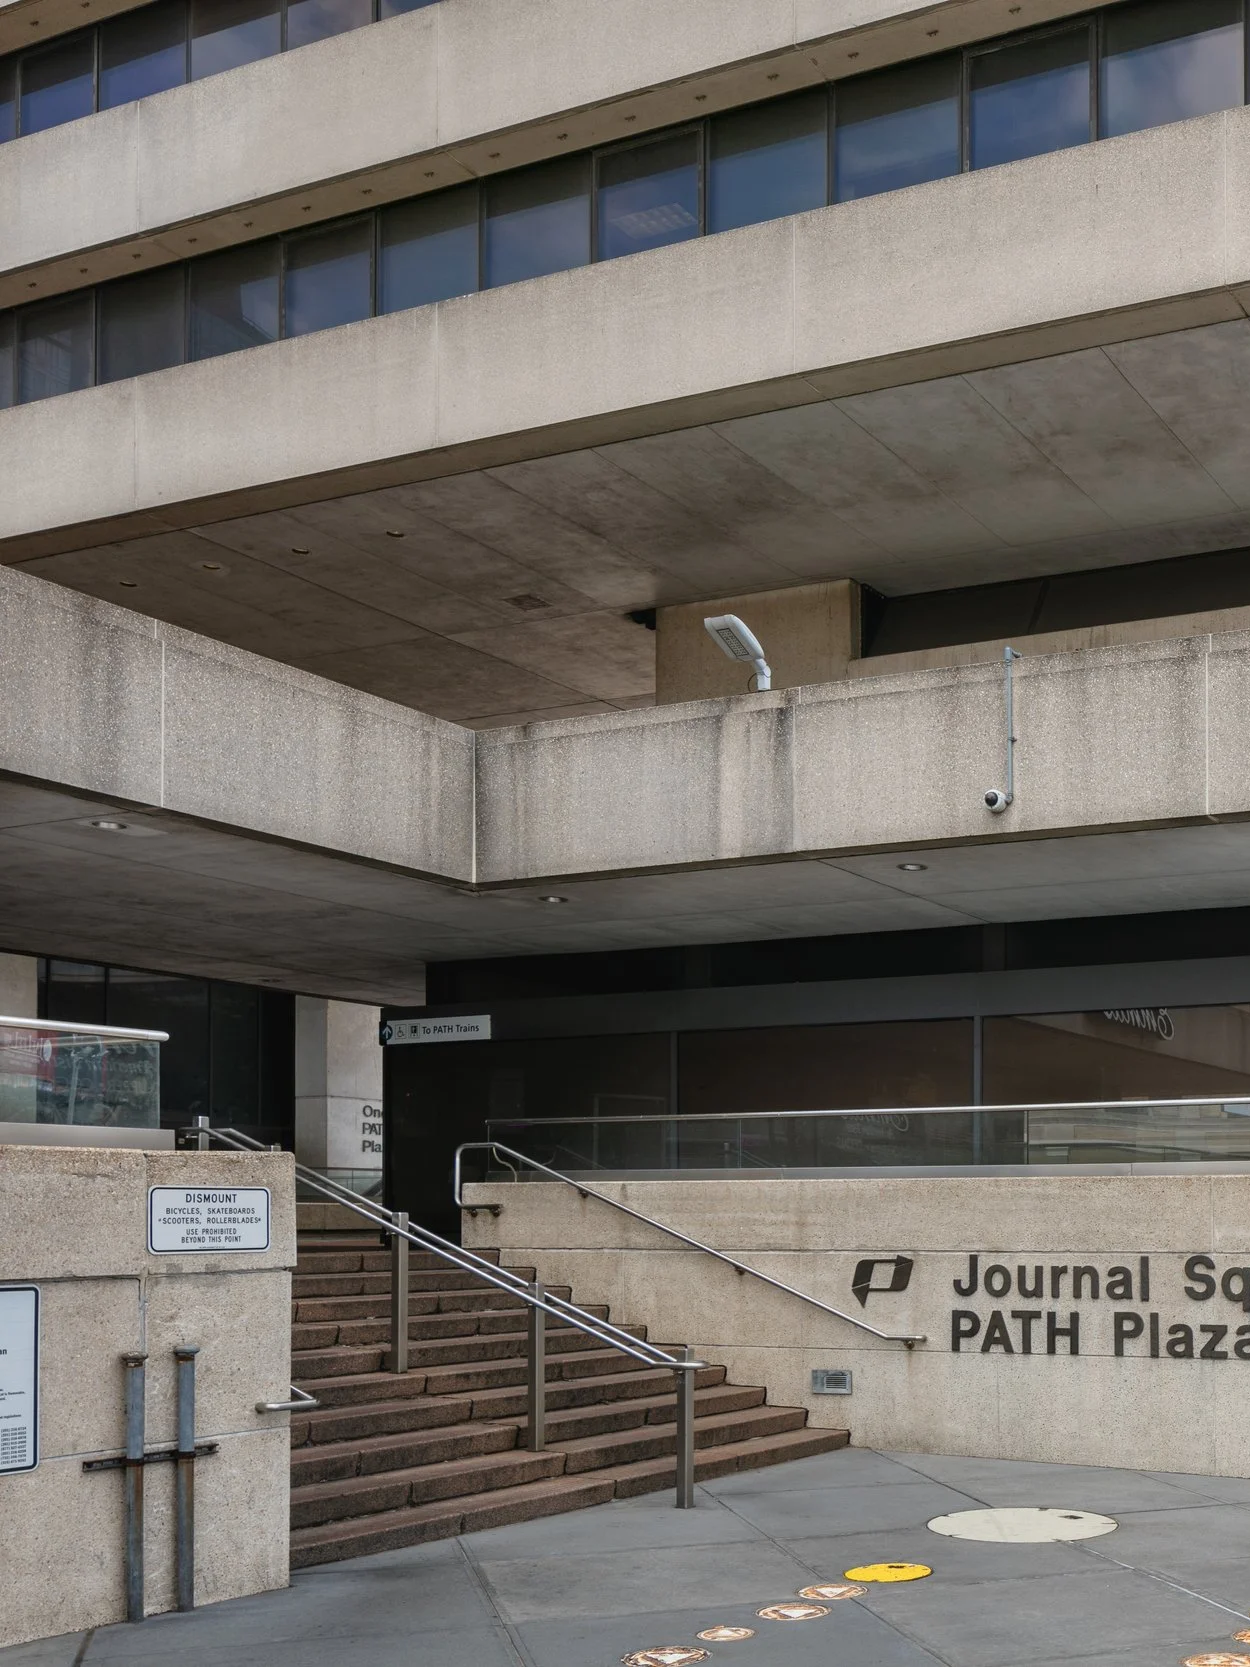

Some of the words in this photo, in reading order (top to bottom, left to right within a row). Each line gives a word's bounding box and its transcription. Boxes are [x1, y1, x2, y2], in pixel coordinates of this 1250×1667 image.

[422, 1026, 431, 1035] To
[433, 1025, 454, 1034] PATH
[456, 1023, 480, 1033] Trains
[362, 1105, 383, 1118] On
[185, 1193, 238, 1204] DISMOUNT
[165, 1207, 202, 1215] BICYCLES,
[207, 1207, 256, 1215] SKATEBOARDS
[186, 1228, 199, 1236] USE
[201, 1227, 237, 1235] PROHIBITED
[181, 1236, 206, 1244] BEYOND
[208, 1235, 222, 1243] THIS
[224, 1235, 241, 1243] POINT
[953, 1253, 1150, 1301] Journal
[951, 1308, 1080, 1356] PATH
